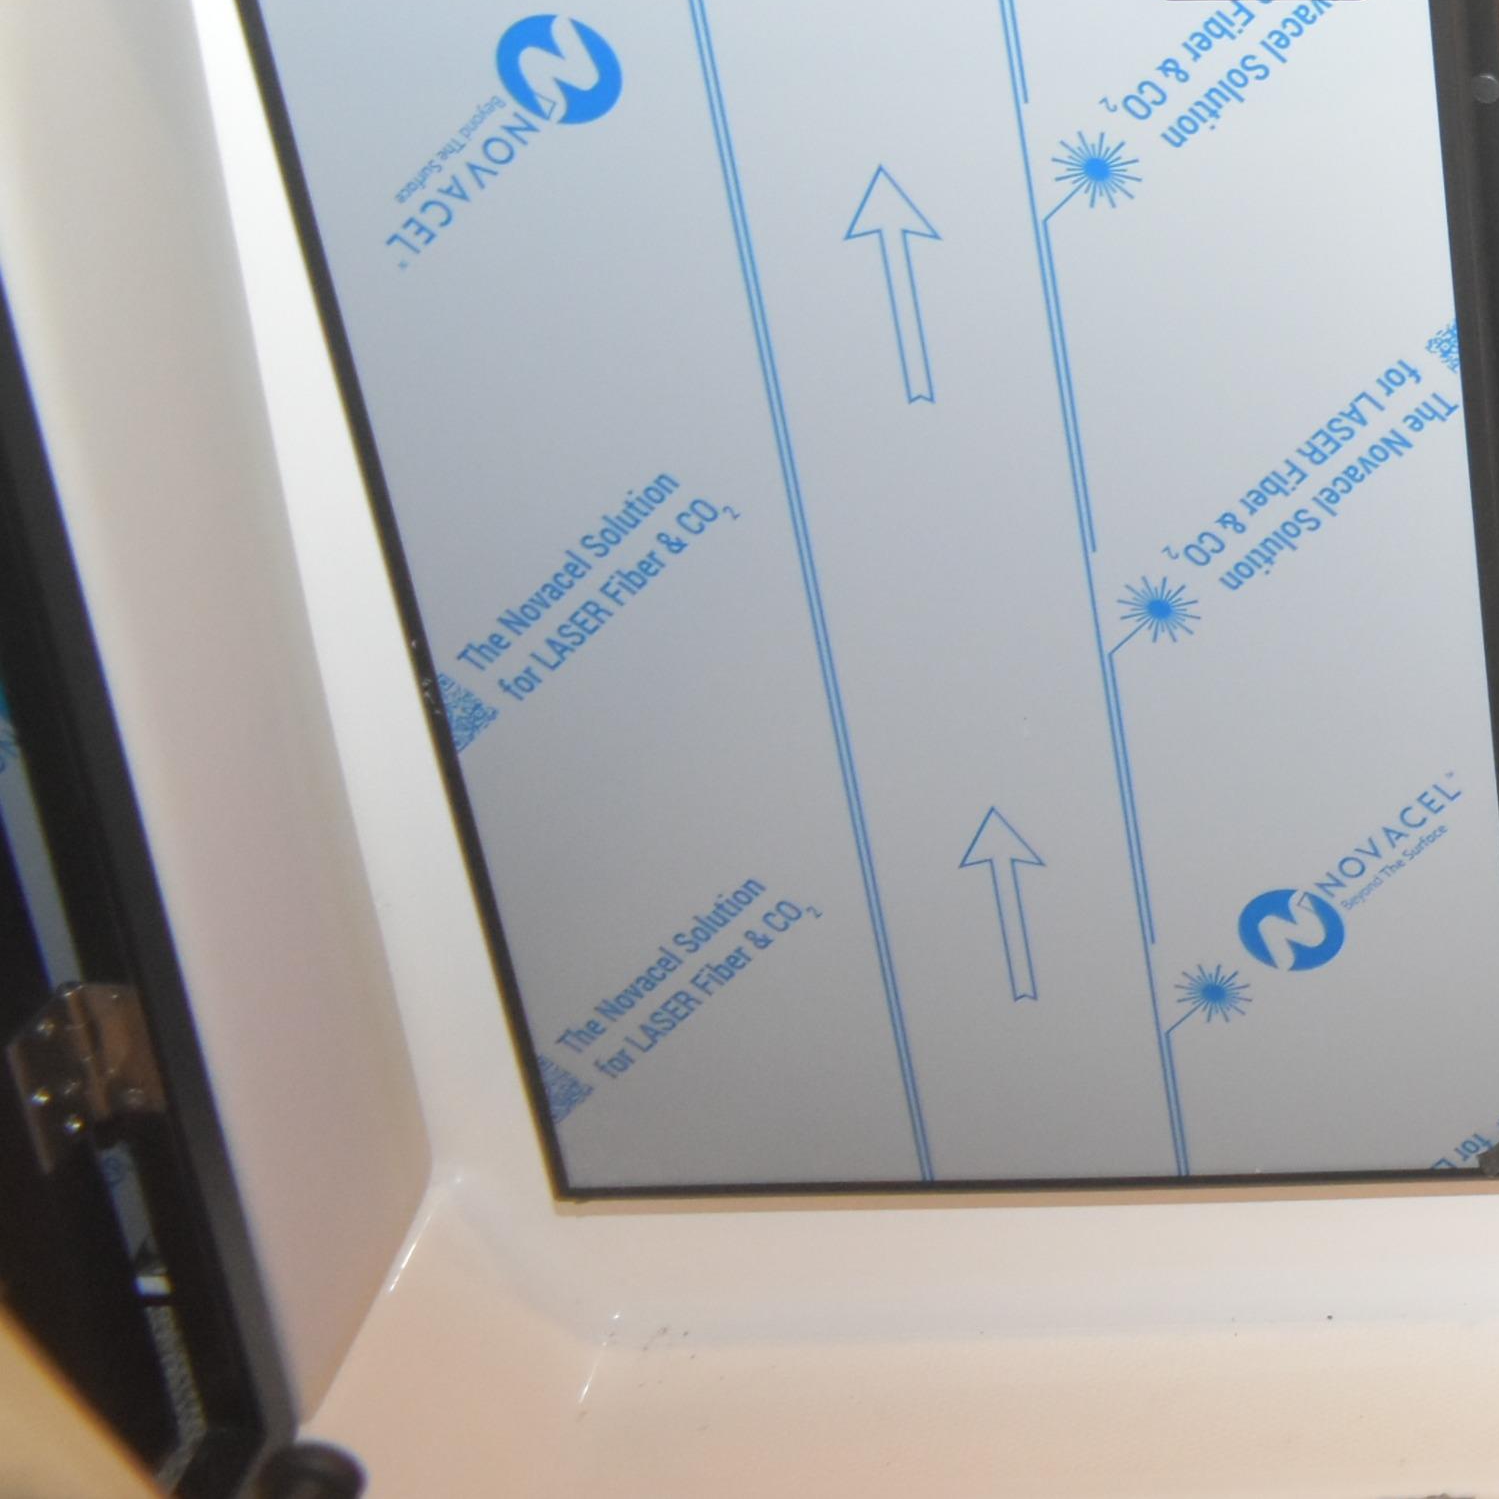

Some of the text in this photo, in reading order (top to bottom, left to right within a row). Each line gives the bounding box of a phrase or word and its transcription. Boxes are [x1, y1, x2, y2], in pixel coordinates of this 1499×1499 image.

[1155, 58, 1190, 83] &
[1160, 54, 1270, 148] Solution
[386, 111, 541, 254] NOVACEL
[395, 95, 507, 203] Beyond The Surface
[1296, 391, 1386, 466] LASER
[1375, 359, 1422, 397] for
[1215, 512, 1247, 535] &
[1219, 392, 1460, 591] The Novacel Solution
[1239, 458, 1309, 516] Fiber
[456, 472, 680, 671] The Novacel Solution
[498, 666, 543, 701] for
[530, 600, 615, 671] LASER
[600, 549, 666, 607] Fiber
[656, 531, 688, 554] &
[1313, 784, 1462, 898] NOVACEL
[1340, 825, 1448, 910] Beyond The Surface
[555, 878, 766, 1052] The Novacel Solution
[594, 1049, 635, 1079] for
[624, 990, 703, 1053] LASER
[690, 946, 752, 996] Fiber
[744, 929, 774, 950] &
